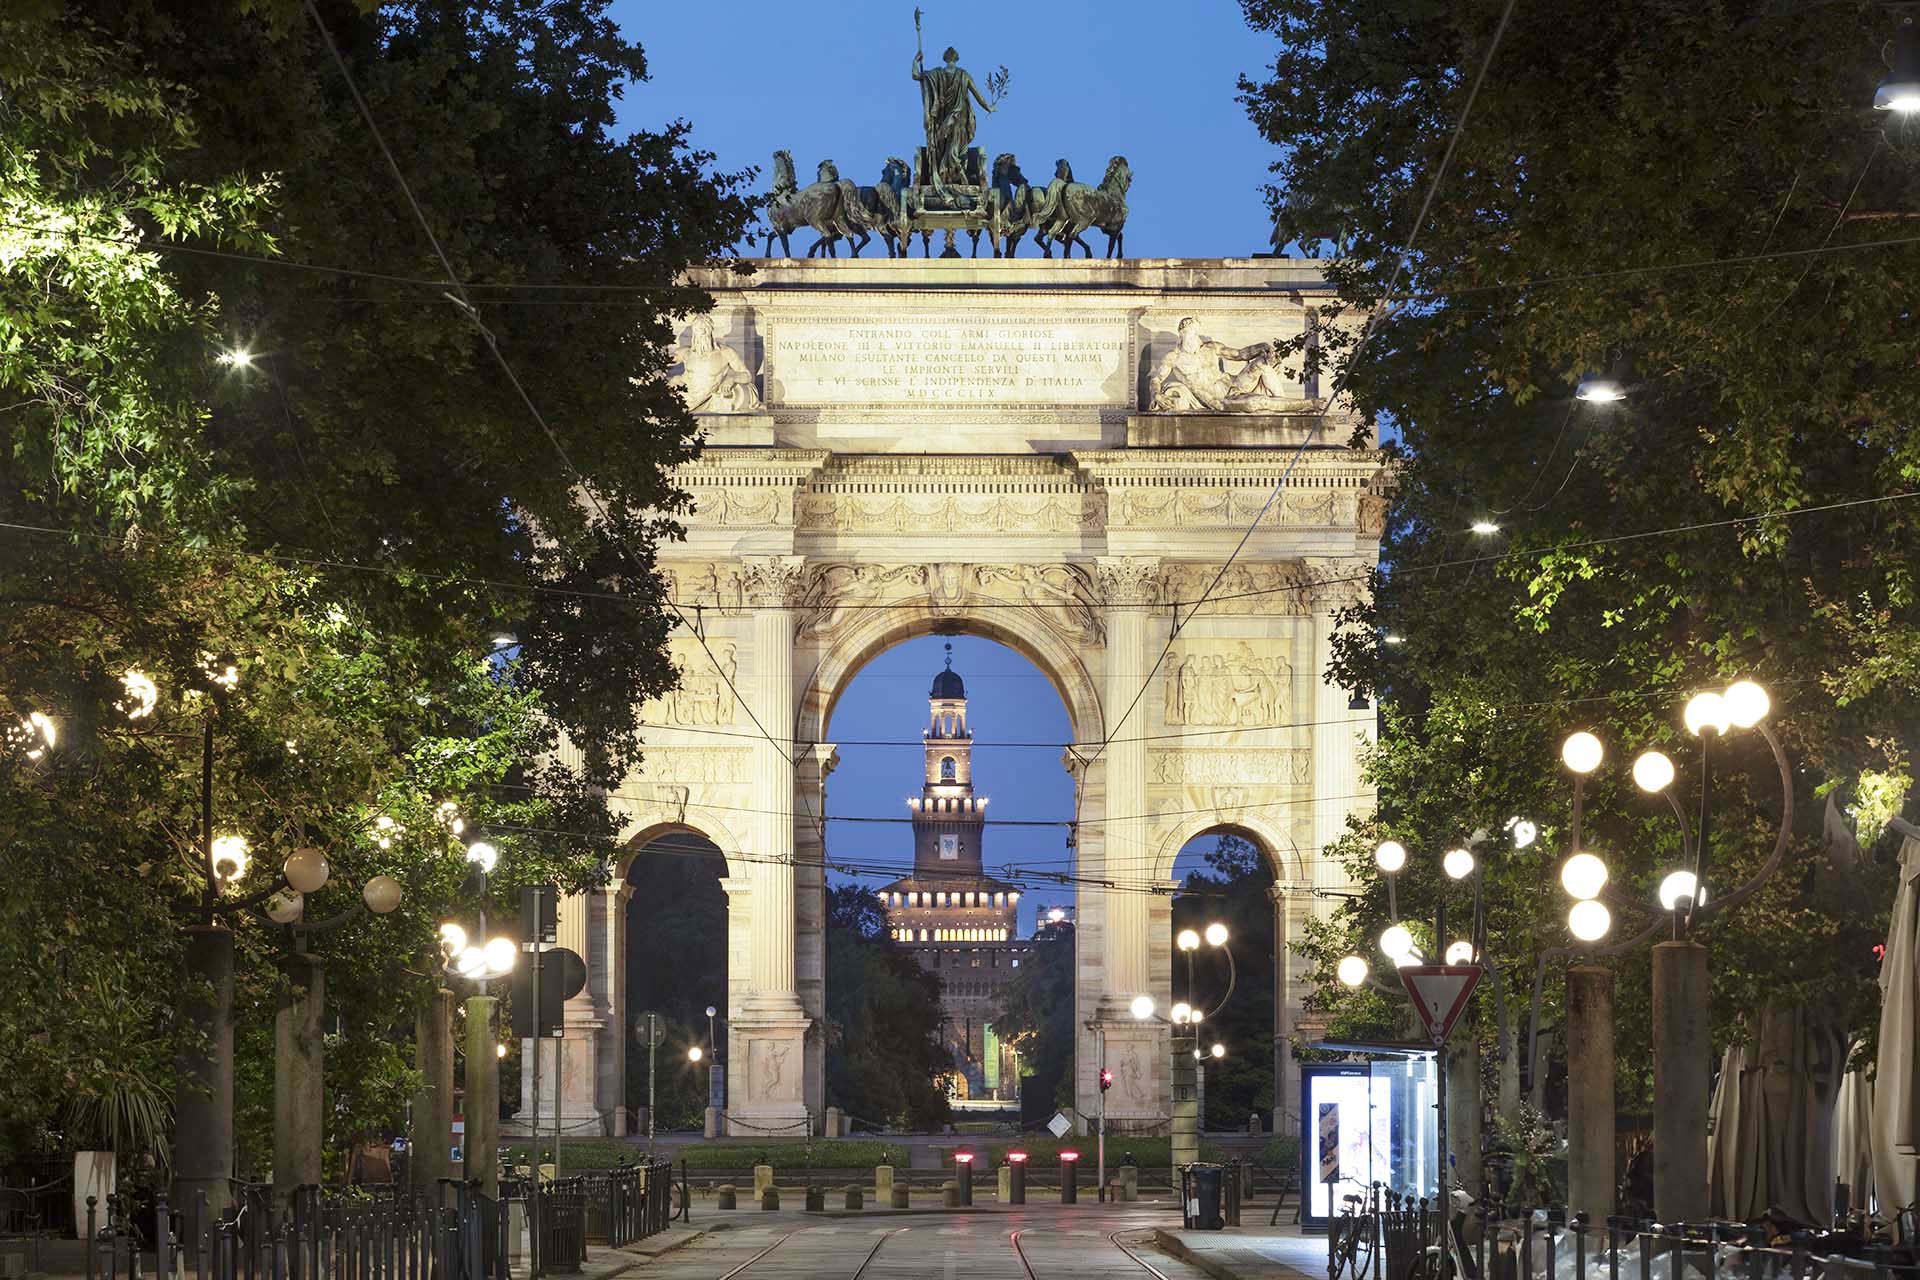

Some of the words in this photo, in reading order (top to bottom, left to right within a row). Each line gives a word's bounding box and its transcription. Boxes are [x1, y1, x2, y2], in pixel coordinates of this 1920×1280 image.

[960, 329, 989, 339] ARMI
[998, 329, 1055, 339] GLORIOSE
[778, 341, 848, 351] NAPOLEONE
[857, 341, 869, 351] III
[895, 341, 952, 351] VITTORIO
[961, 341, 1024, 351] EMANUELE
[1033, 341, 1041, 351] II
[1051, 341, 1123, 351] LIBERATORI
[799, 353, 846, 363] MILANO
[855, 353, 917, 363] ESULTANTE
[925, 353, 985, 363] CANCELLO
[993, 353, 1008, 363] DA
[1016, 353, 1057, 363] QUESTI
[1064, 353, 1102, 363] MARMI
[883, 365, 895, 375] LE
[904, 365, 965, 375] IMPRONTE
[974, 365, 1020, 375] SERVILI
[834, 376, 846, 386] VI
[855, 376, 901, 387] SCRISSE
[924, 376, 1016, 386] INDIPENDENZA
[1043, 376, 1084, 386] ITALIA
